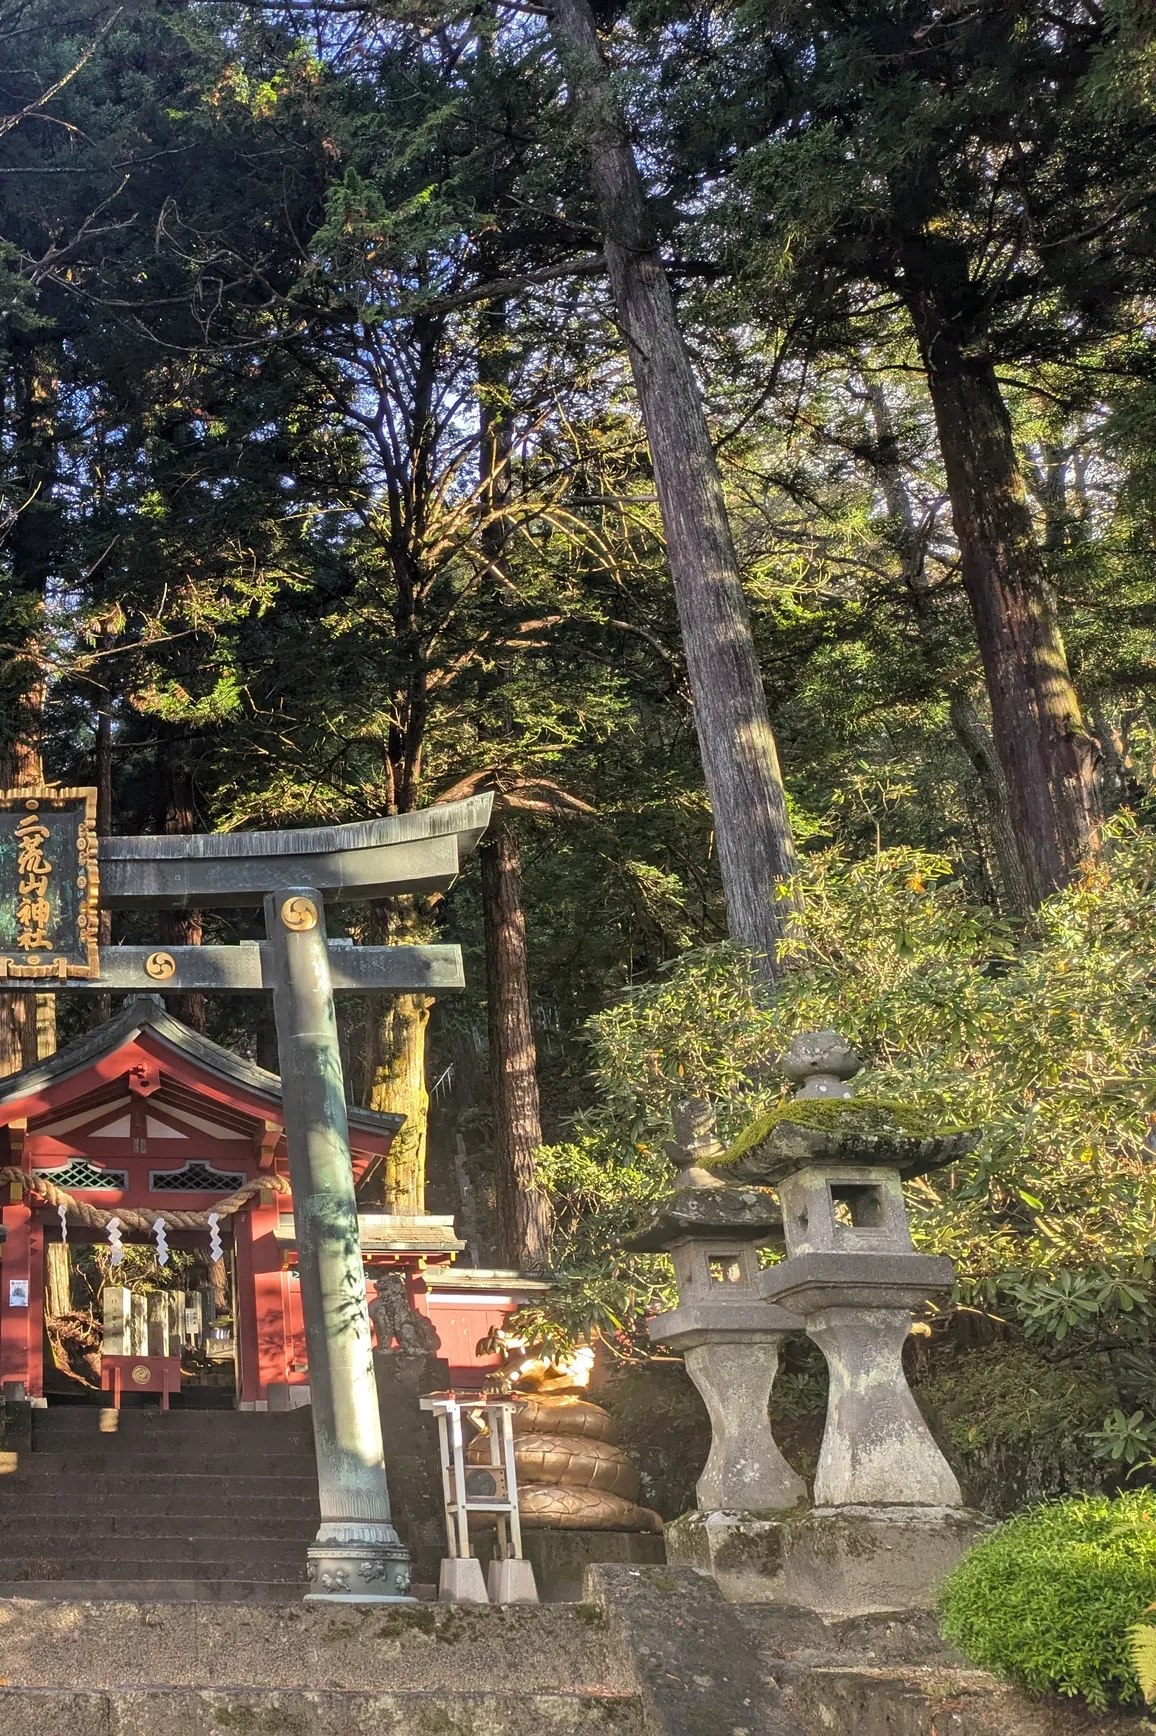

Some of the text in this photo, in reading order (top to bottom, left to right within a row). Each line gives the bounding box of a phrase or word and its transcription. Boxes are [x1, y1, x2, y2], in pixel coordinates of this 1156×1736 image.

[14, 814, 53, 951] 二荒山神社
